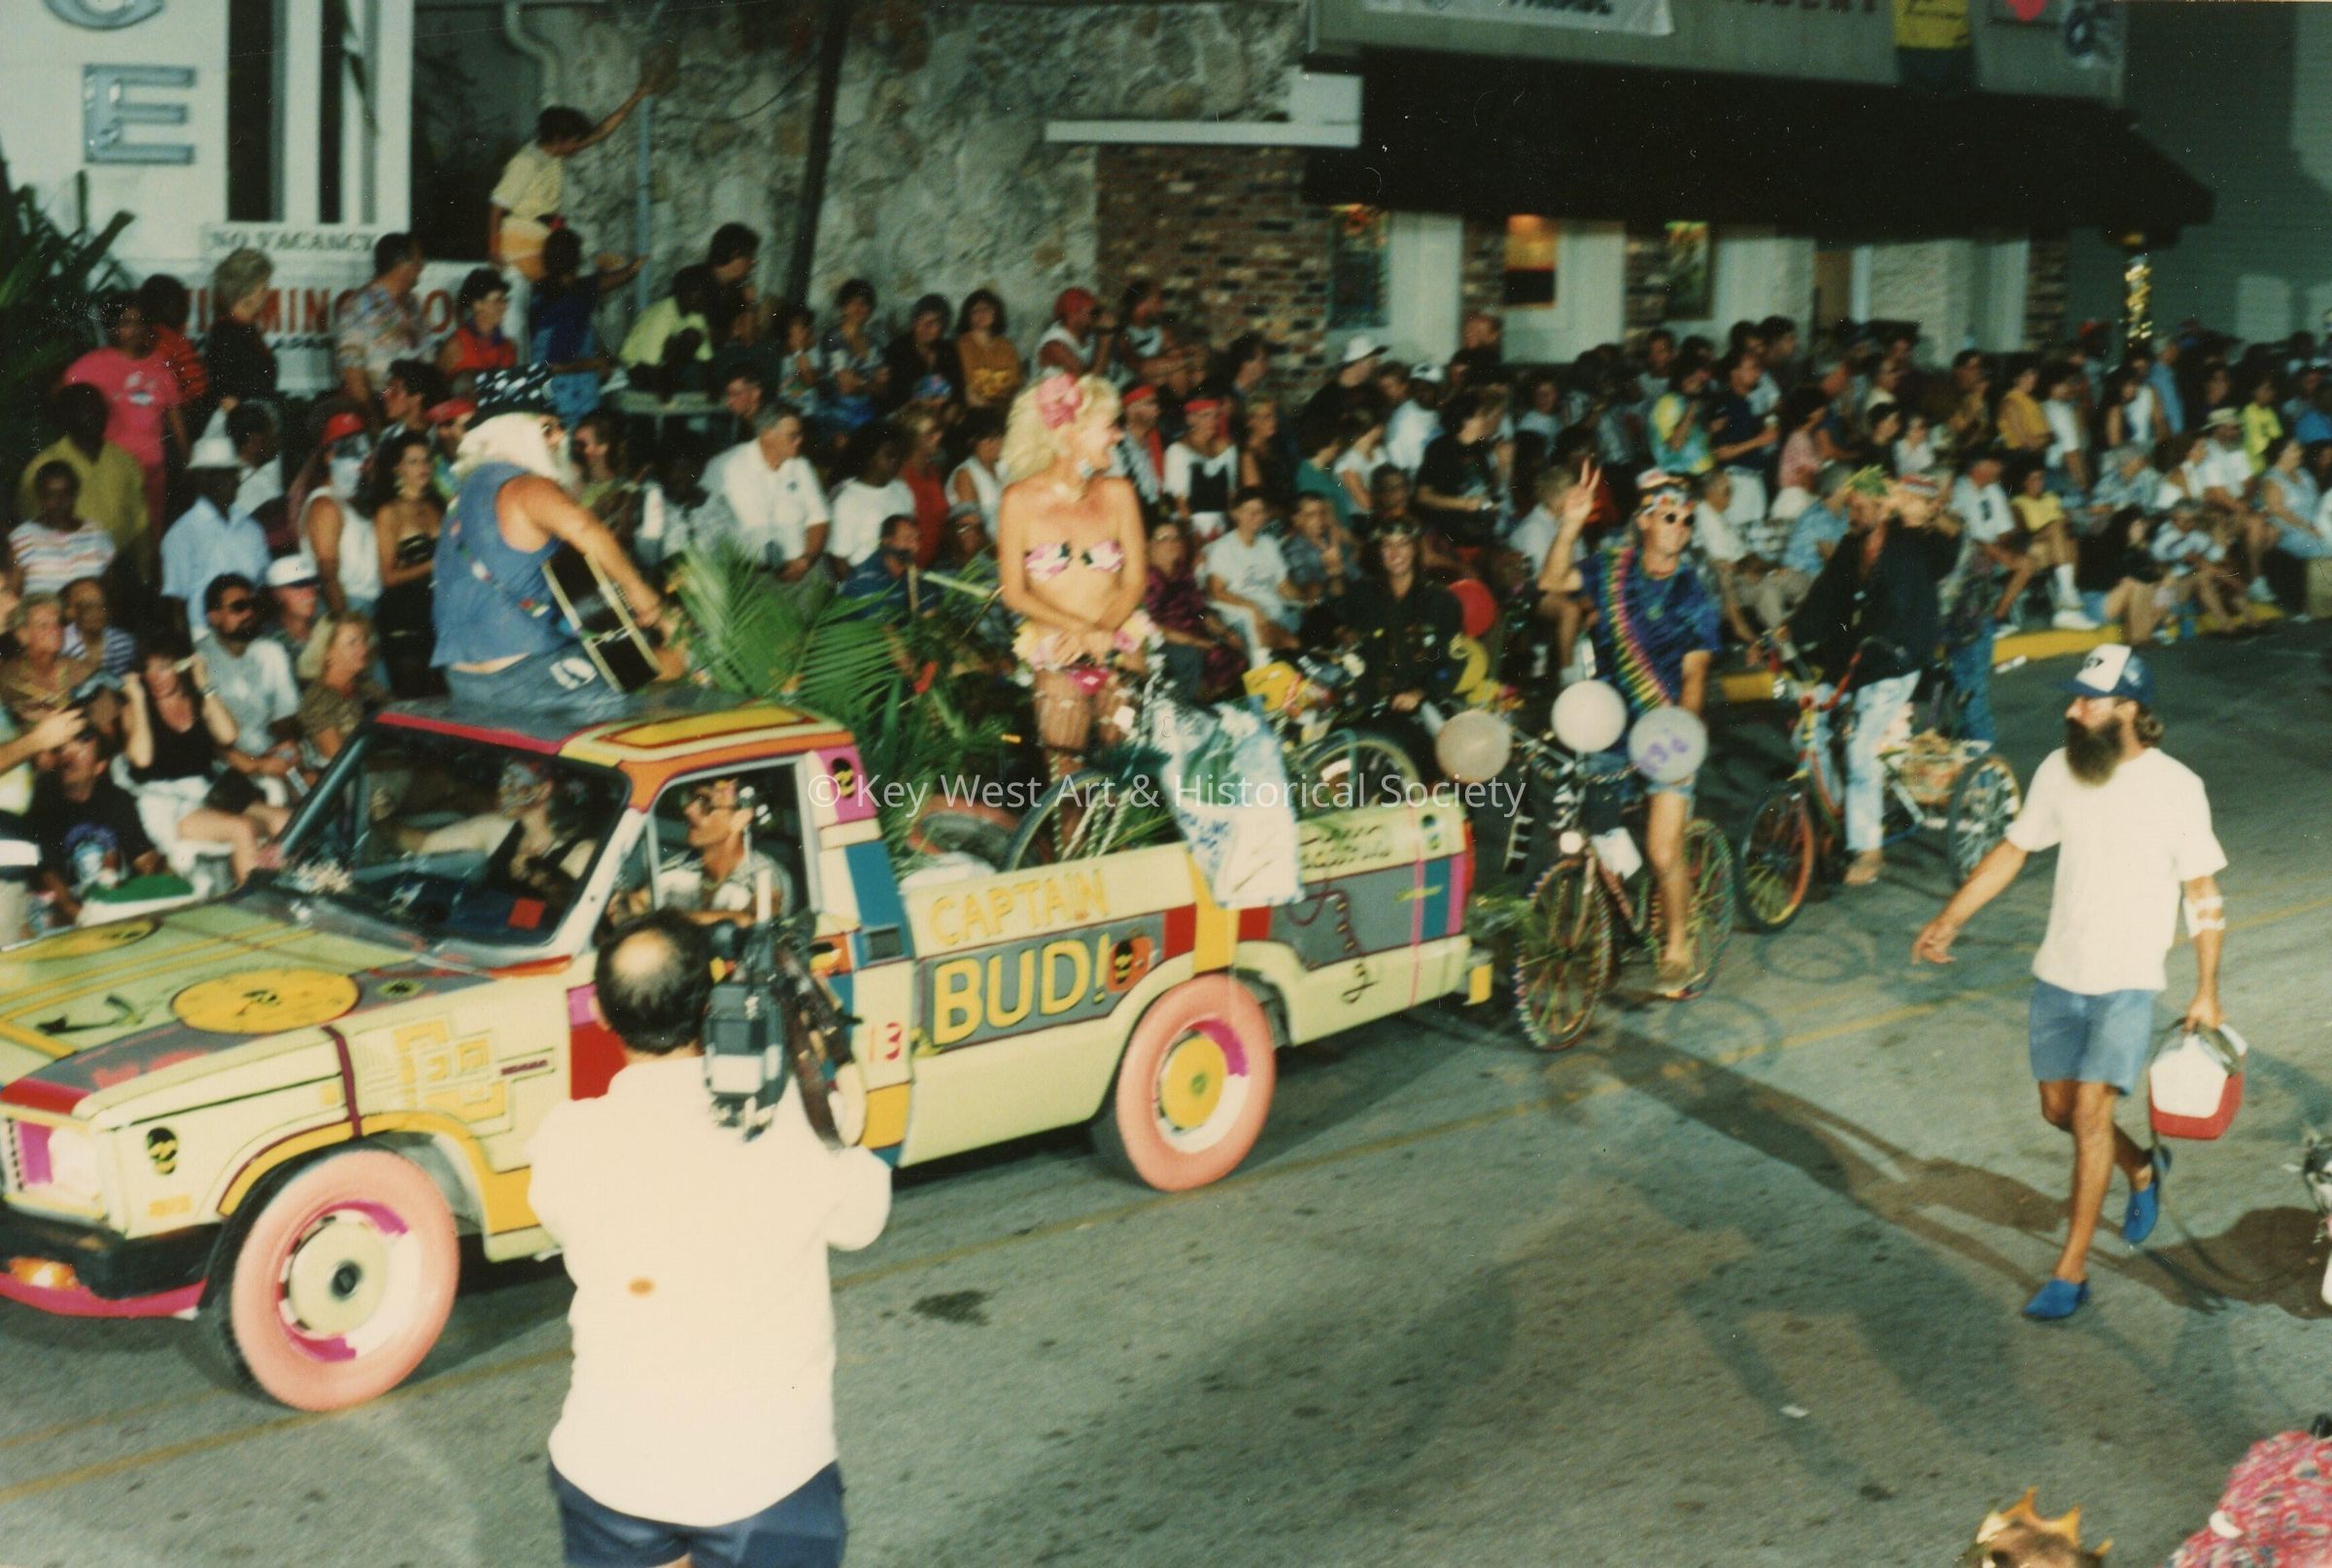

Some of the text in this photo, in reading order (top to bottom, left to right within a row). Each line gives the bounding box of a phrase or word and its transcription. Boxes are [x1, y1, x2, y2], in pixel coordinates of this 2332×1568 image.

[255, 231, 377, 253] VACANCY
[929, 869, 1112, 946] CAPTAIN
[932, 932, 1112, 1046] BUD!
